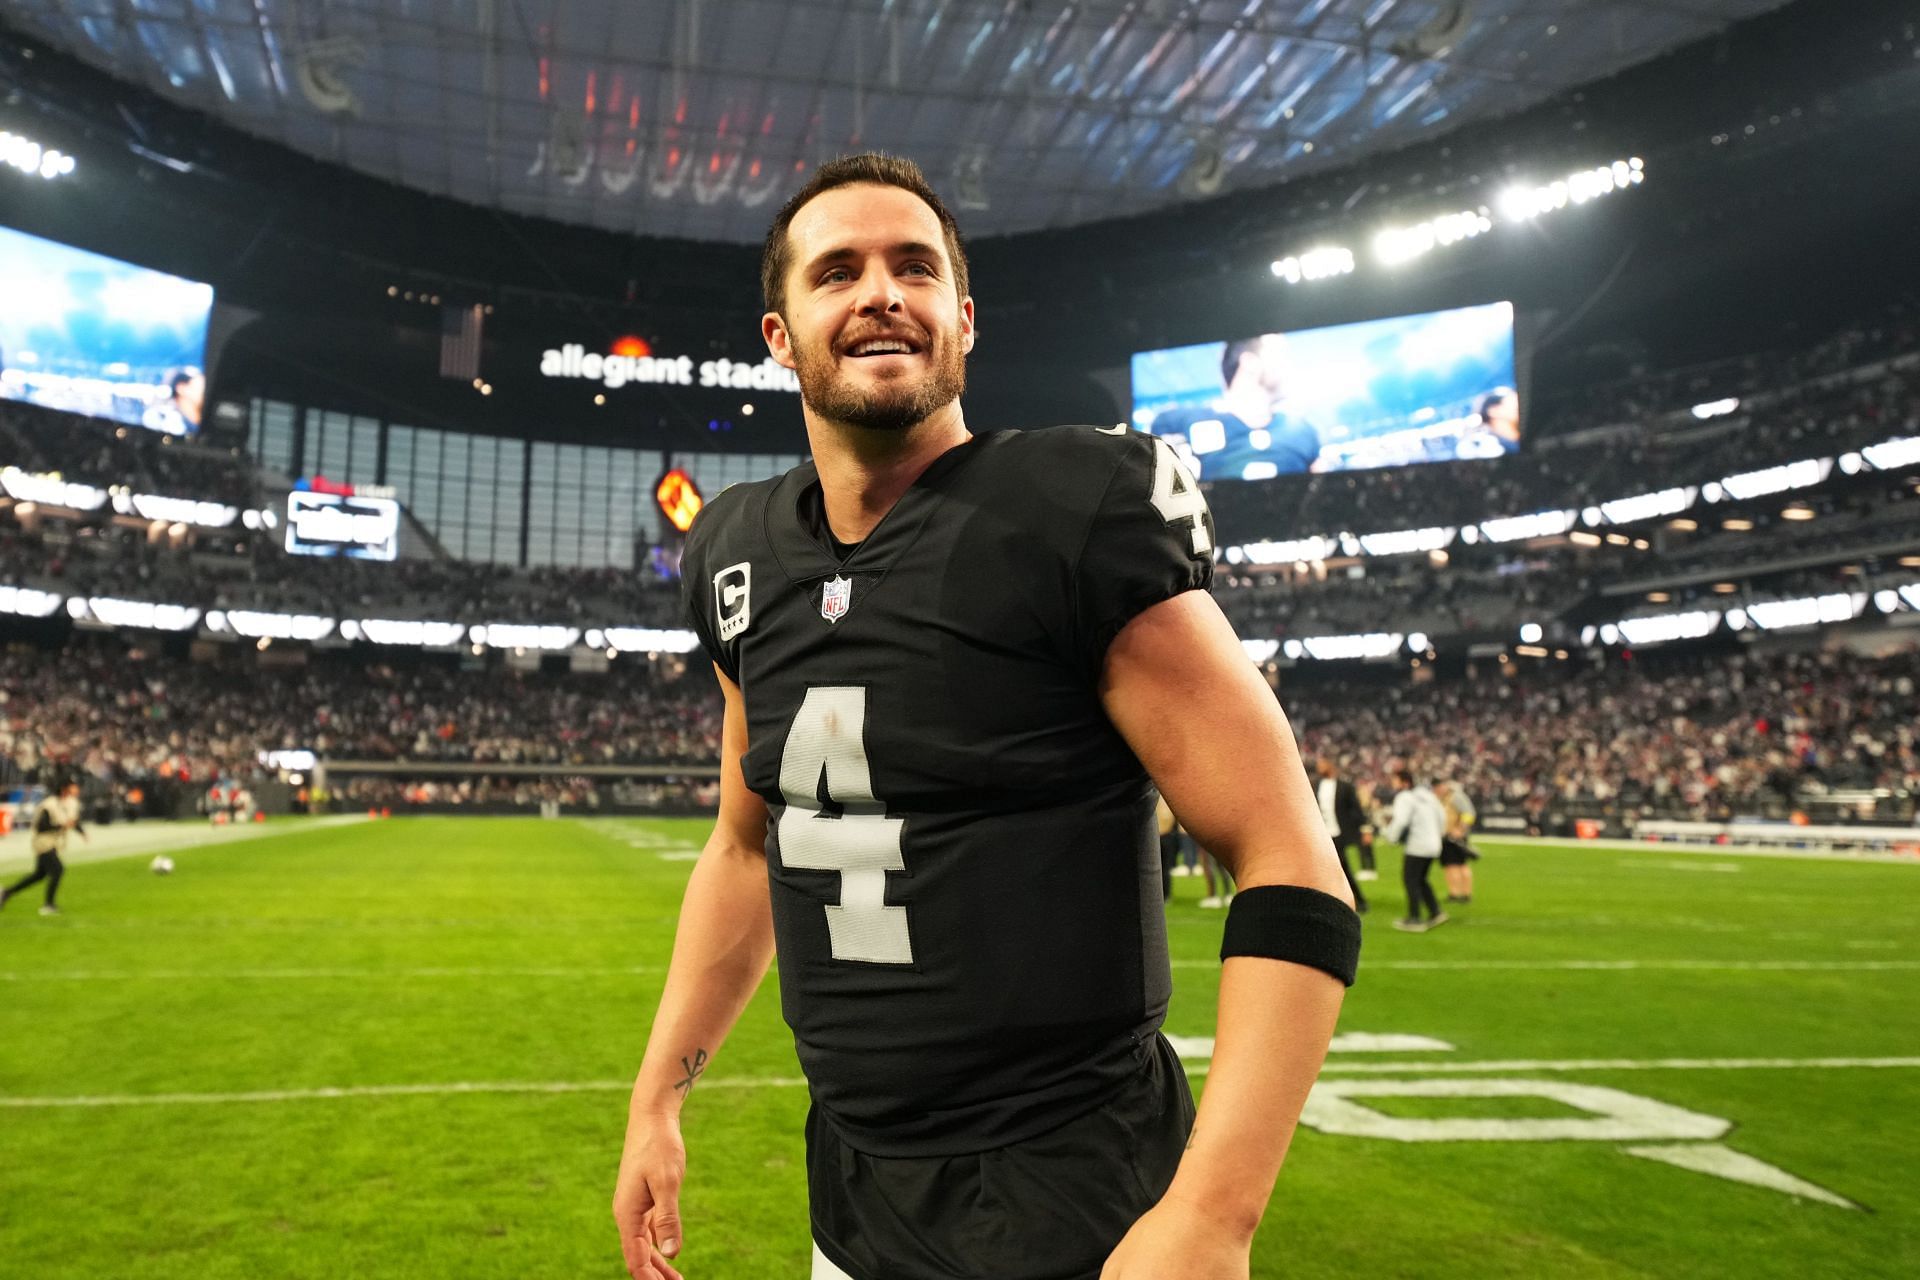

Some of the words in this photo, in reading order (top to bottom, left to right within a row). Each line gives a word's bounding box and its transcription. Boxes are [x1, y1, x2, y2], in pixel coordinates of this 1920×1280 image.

[540, 343, 694, 388] allegiant
[699, 357, 802, 392] stadiu
[1150, 439, 1212, 554] 4
[717, 569, 746, 621] C
[824, 596, 845, 615] NFL
[778, 686, 913, 964] 4
